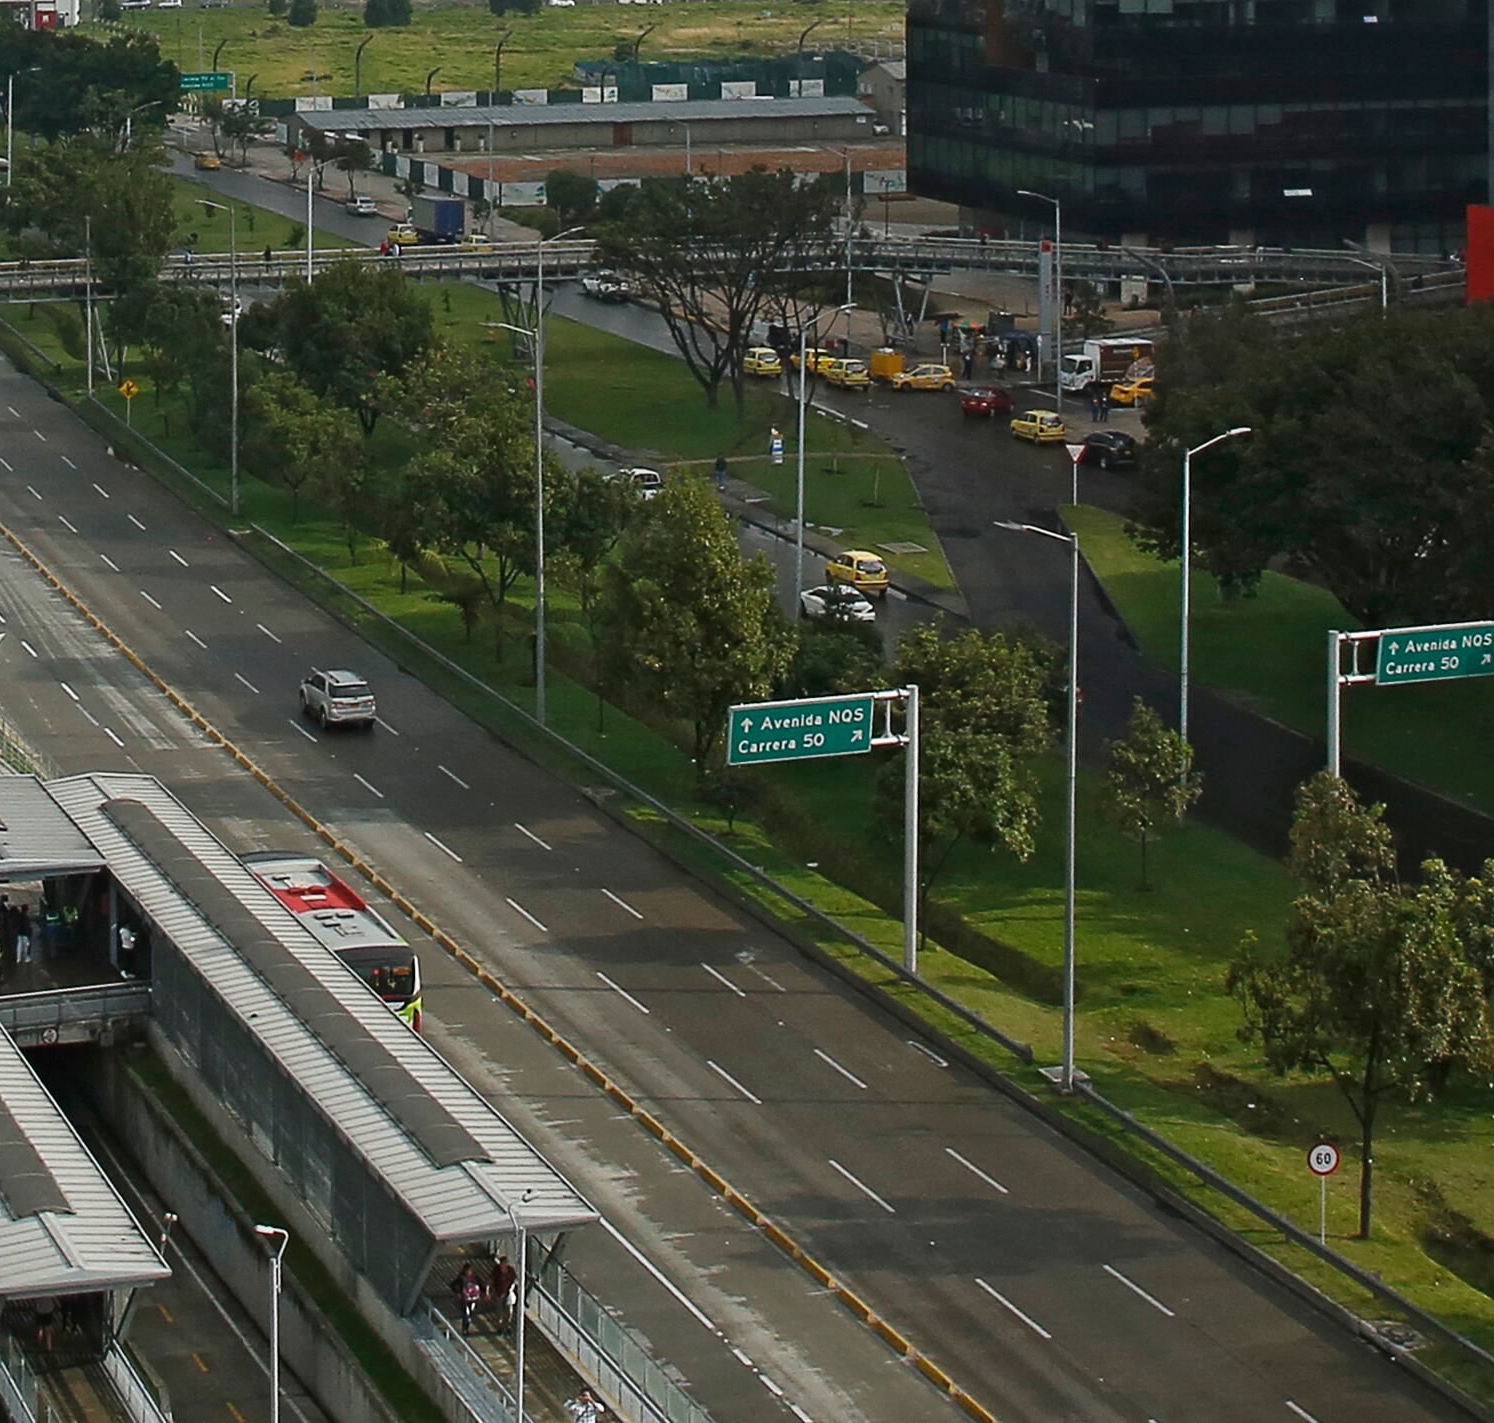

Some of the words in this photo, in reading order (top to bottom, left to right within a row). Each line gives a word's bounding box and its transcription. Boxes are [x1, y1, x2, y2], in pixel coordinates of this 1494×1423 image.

[1404, 639, 1457, 654] Avenida
[1462, 633, 1492, 649] NQS
[1386, 661, 1435, 675] Carrera
[1440, 656, 1460, 670] 50
[761, 714, 823, 731] Avenida
[828, 708, 864, 724] NQS
[738, 738, 796, 754] Carrera
[803, 733, 825, 748] 50
[1317, 1152, 1331, 1164] 60
